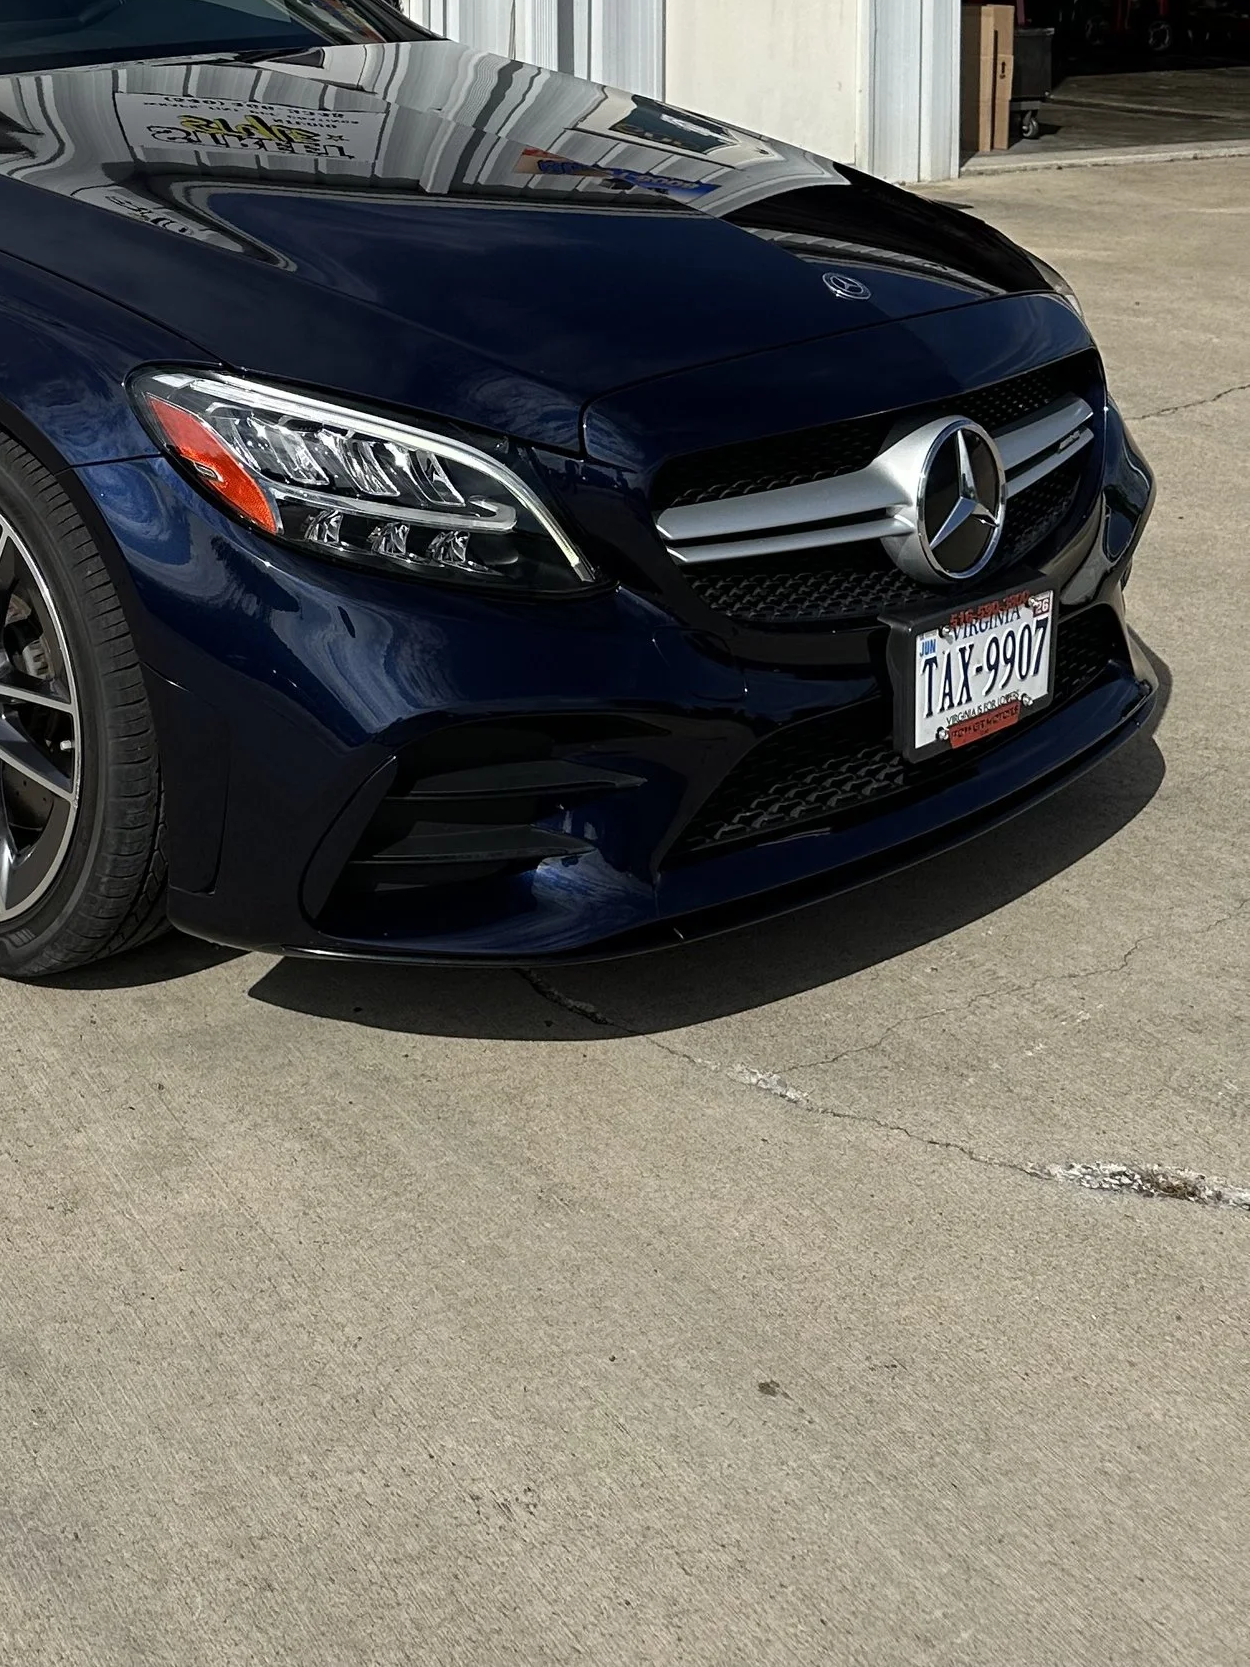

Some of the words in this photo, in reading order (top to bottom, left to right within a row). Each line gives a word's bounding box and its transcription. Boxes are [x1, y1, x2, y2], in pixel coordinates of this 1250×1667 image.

[1033, 599, 1049, 614] 26
[920, 638, 937, 657] JUN
[922, 617, 1049, 719] TAX-9907
